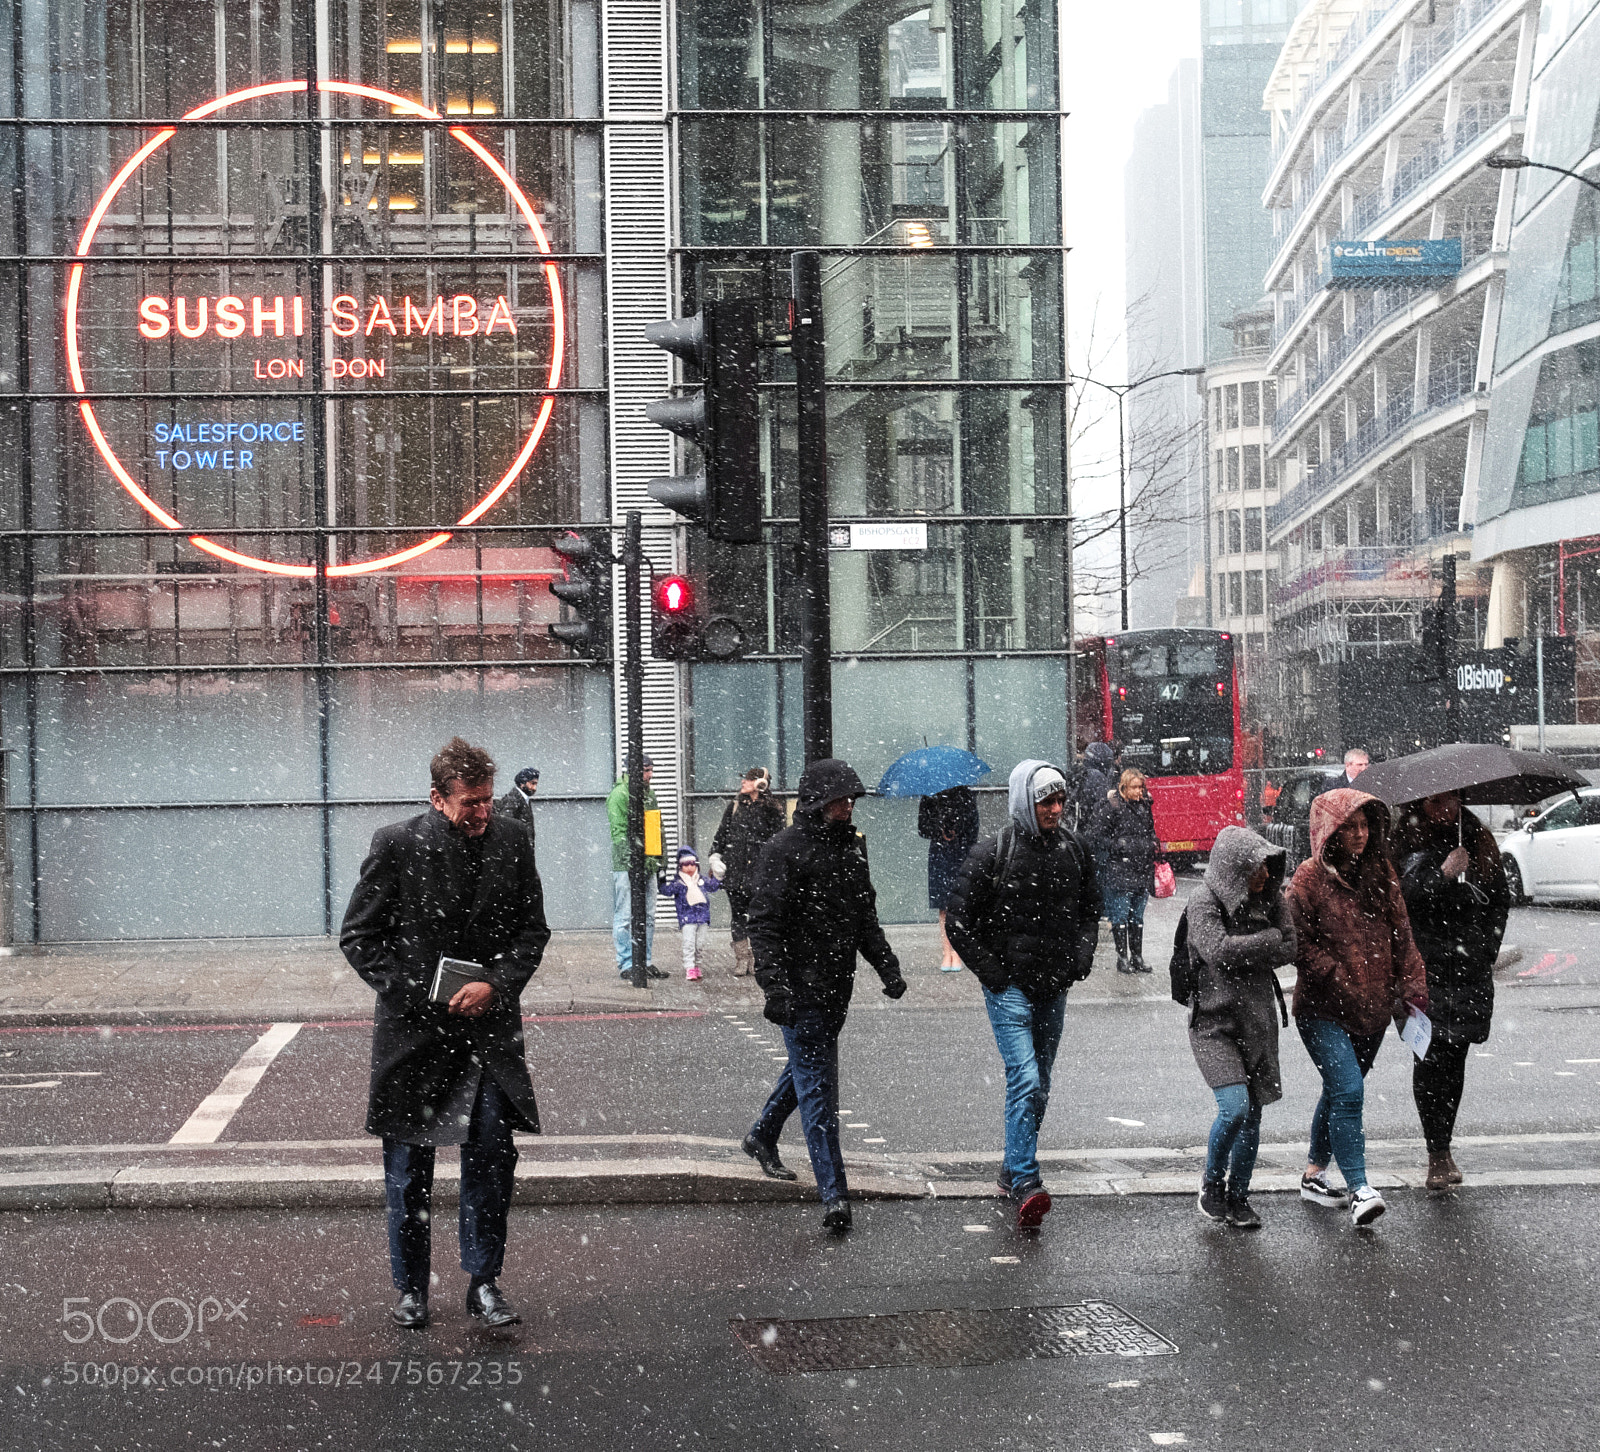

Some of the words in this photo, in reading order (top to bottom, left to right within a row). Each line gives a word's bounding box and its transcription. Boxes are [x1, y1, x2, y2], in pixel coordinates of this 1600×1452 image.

[138, 295, 303, 338] SUSHI
[330, 294, 518, 337] SAMBA
[254, 358, 304, 380] LON
[332, 358, 385, 379] DON
[154, 421, 304, 443] SALESFORCE
[156, 449, 254, 471] TOWER
[859, 527, 919, 536] BISHOPSGATE
[903, 537, 919, 545] EC2
[1161, 684, 1181, 700] 42
